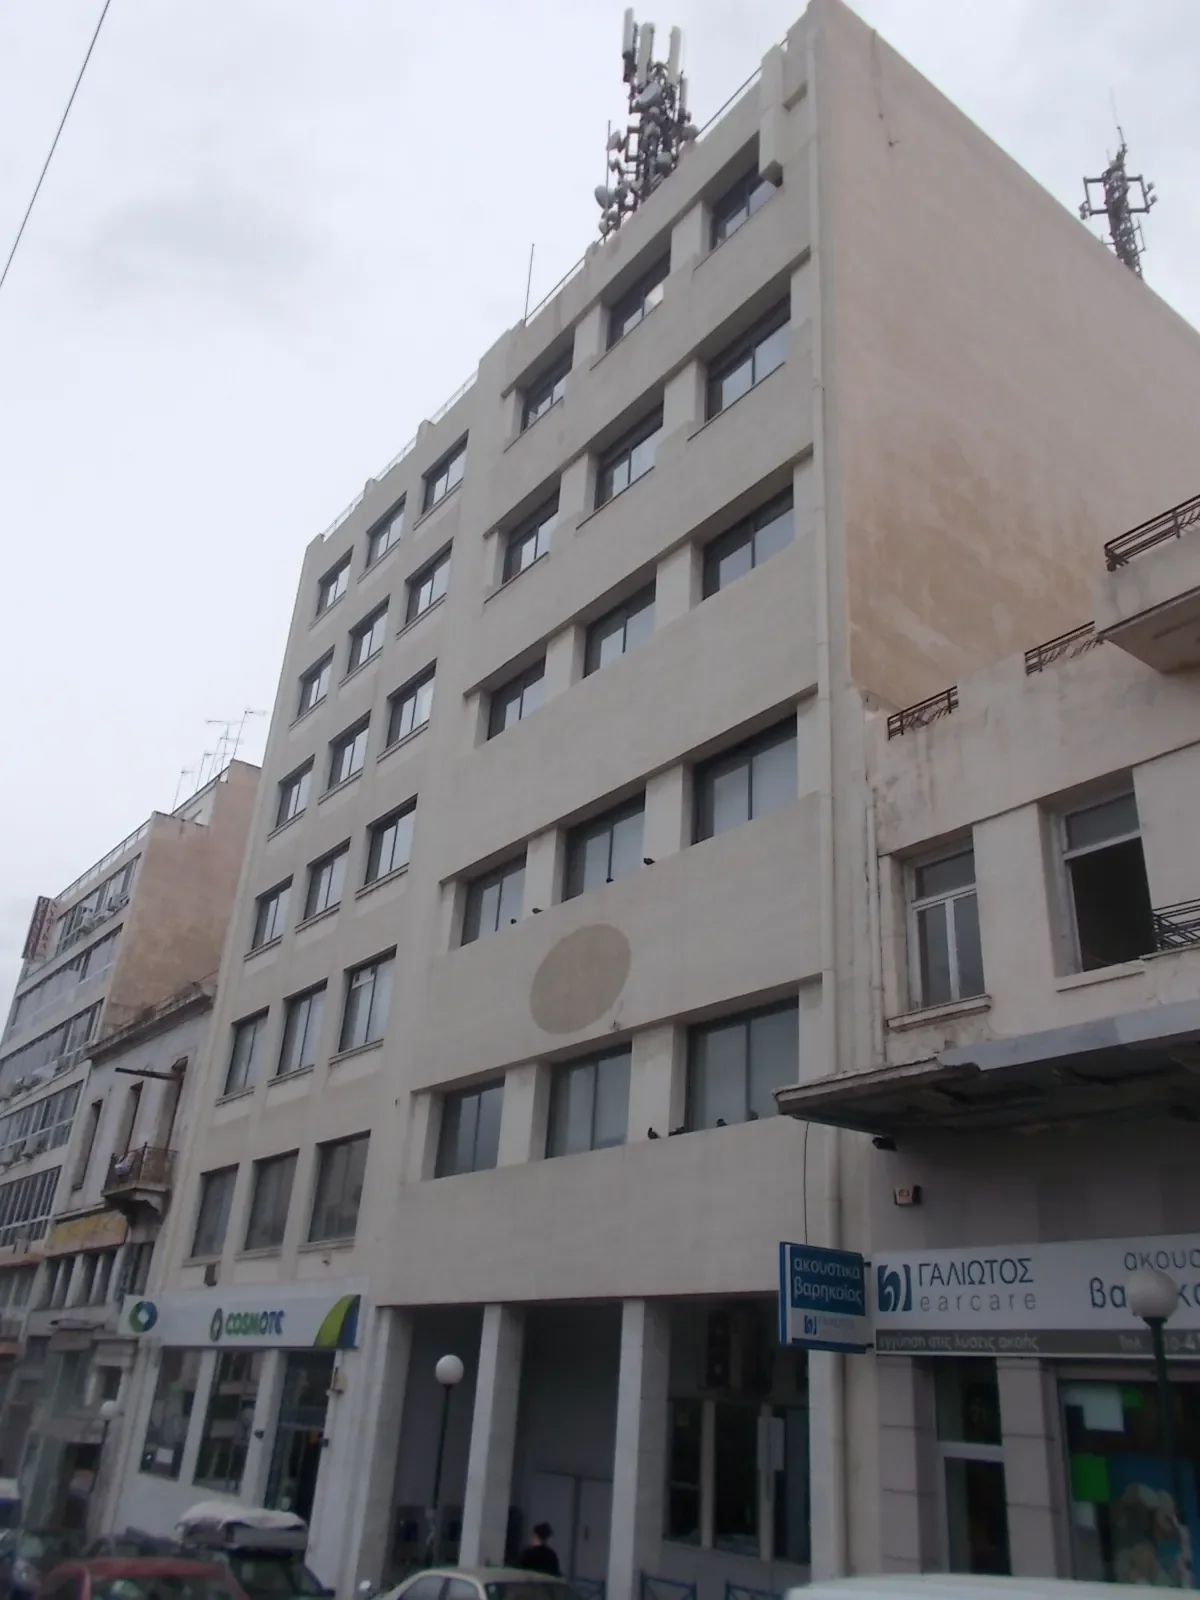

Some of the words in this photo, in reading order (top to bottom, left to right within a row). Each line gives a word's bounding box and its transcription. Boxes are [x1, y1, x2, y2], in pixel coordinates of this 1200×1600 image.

[920, 1258, 1034, 1288] ΓΑΛΙΩΤΟΣ
[920, 1293, 1036, 1315] earcare
[226, 1311, 286, 1336] COSMOTE
